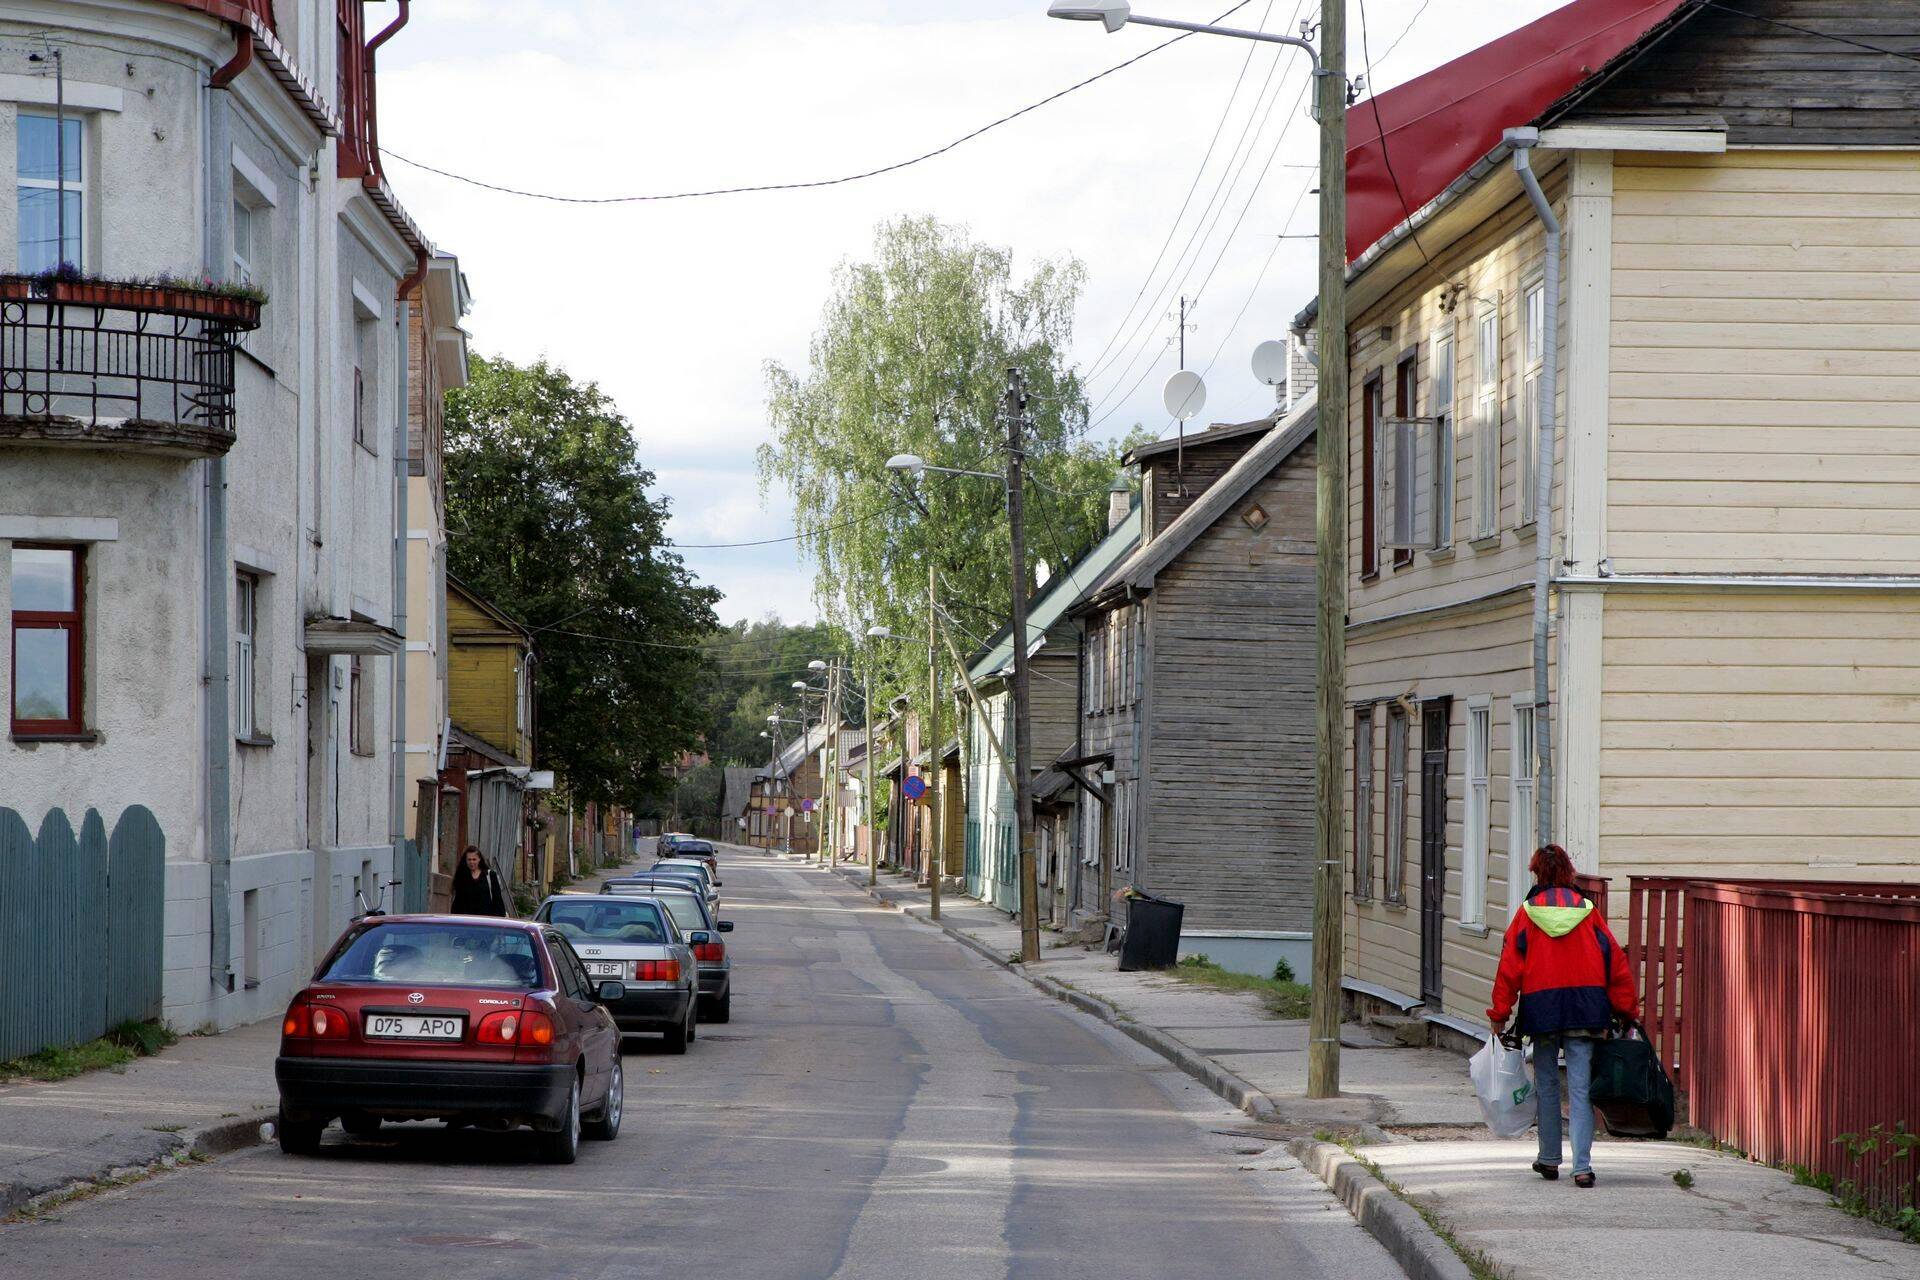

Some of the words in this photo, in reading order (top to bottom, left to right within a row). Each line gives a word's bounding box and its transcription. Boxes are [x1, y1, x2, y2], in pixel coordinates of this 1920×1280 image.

[597, 963, 618, 974] TBF
[374, 1018, 403, 1034] 075
[418, 1019, 456, 1035] APO
